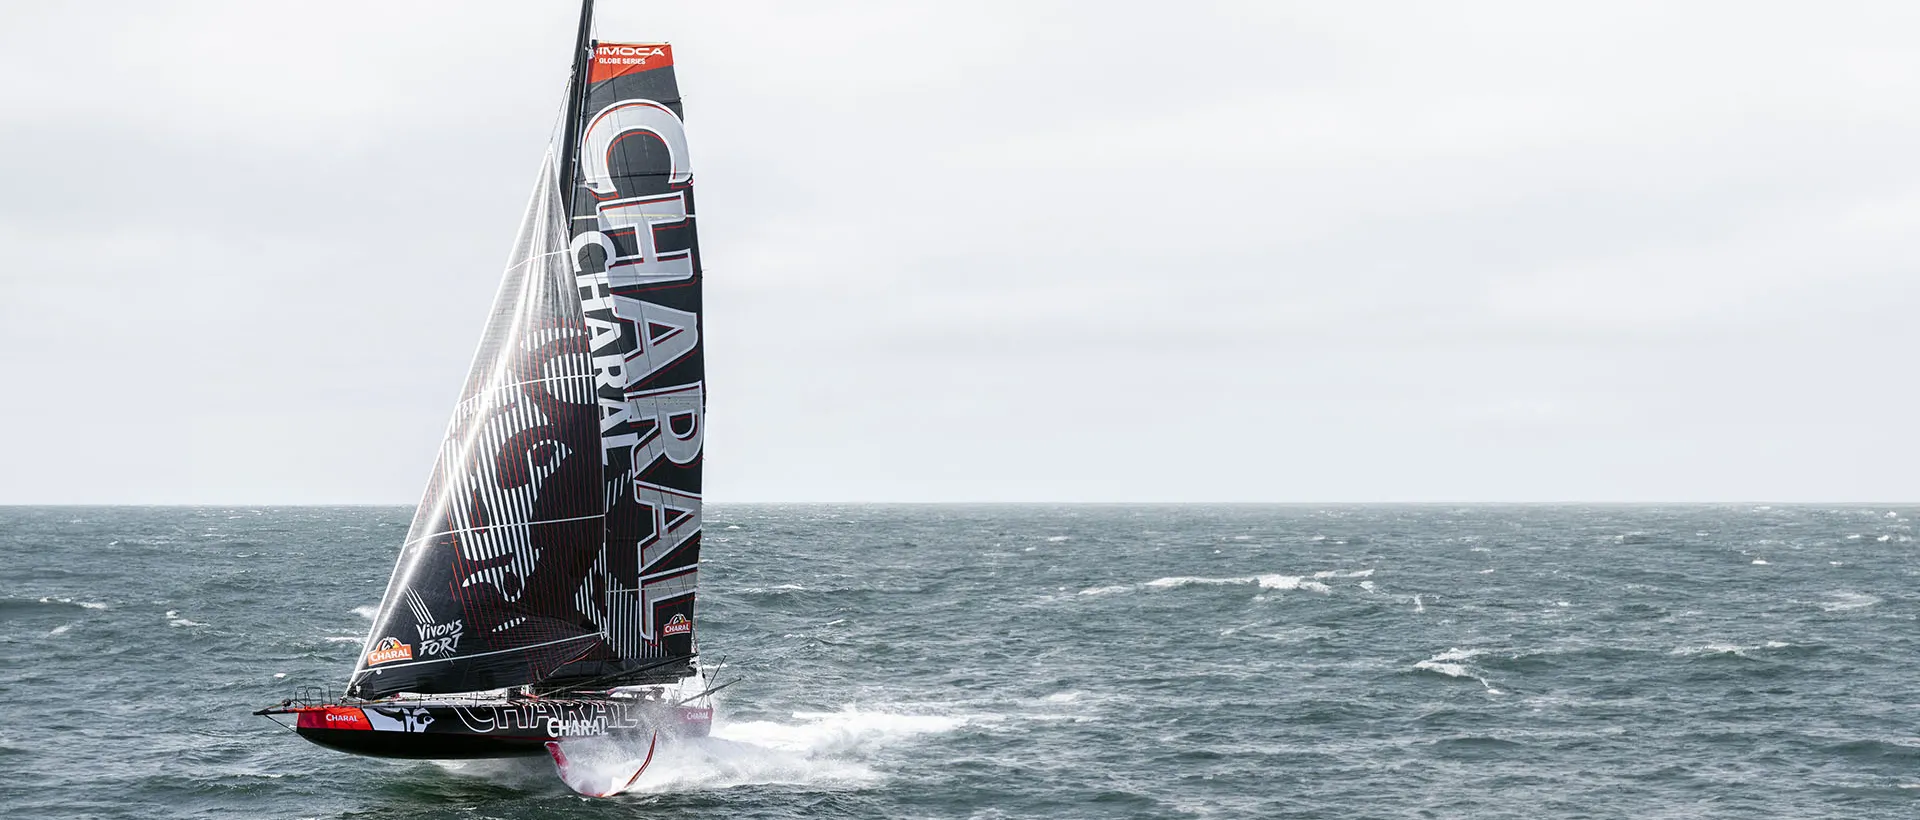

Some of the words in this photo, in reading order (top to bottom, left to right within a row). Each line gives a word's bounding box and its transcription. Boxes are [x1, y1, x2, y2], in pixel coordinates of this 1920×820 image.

[597, 47, 665, 56] IMOCA
[599, 57, 621, 65] GLOBE
[571, 231, 639, 466] CHARAL
[581, 98, 704, 642] CHARAL
[419, 632, 464, 656] FORT
[370, 649, 411, 663] CHARAL
[325, 713, 359, 722] CHARAL
[547, 717, 609, 738] CHARAL
